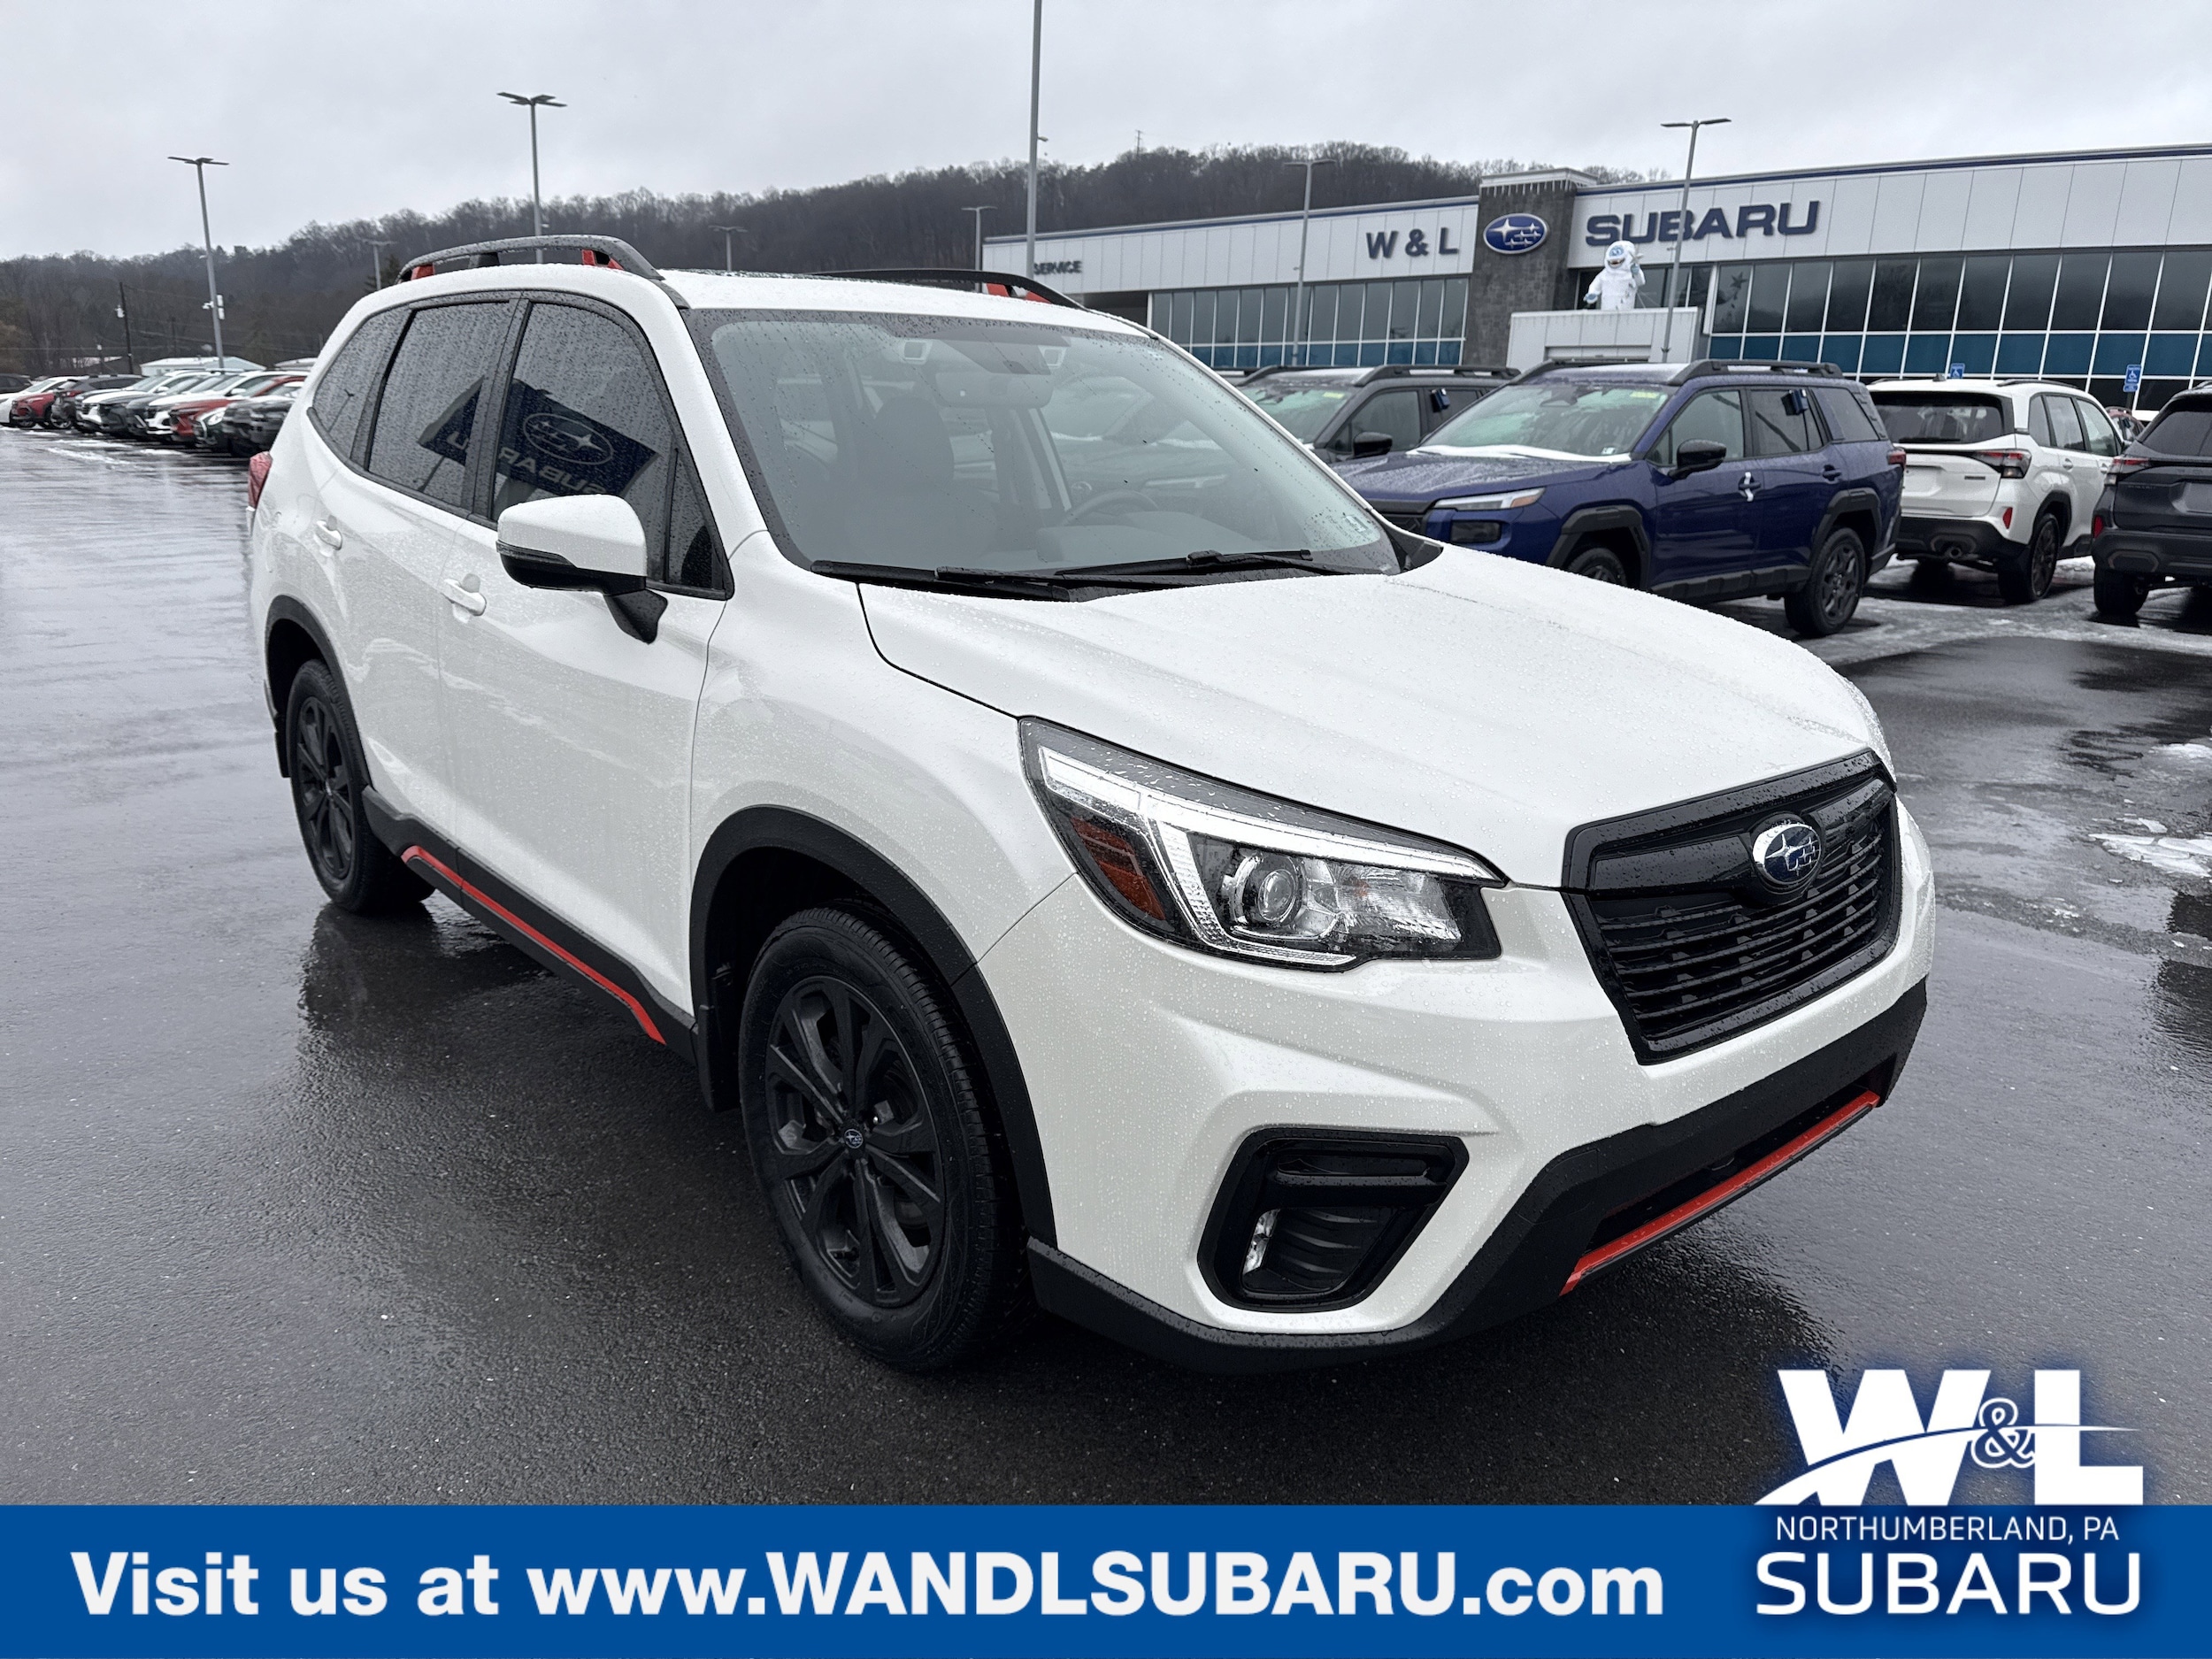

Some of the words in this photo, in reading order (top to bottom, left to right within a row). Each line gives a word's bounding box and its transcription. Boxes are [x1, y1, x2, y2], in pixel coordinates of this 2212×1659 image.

[1586, 200, 1820, 247] SUBARU
[1365, 230, 1399, 260] W
[1405, 228, 1429, 257] &
[1439, 227, 1460, 255] L
[1033, 260, 1082, 275] SERVICE
